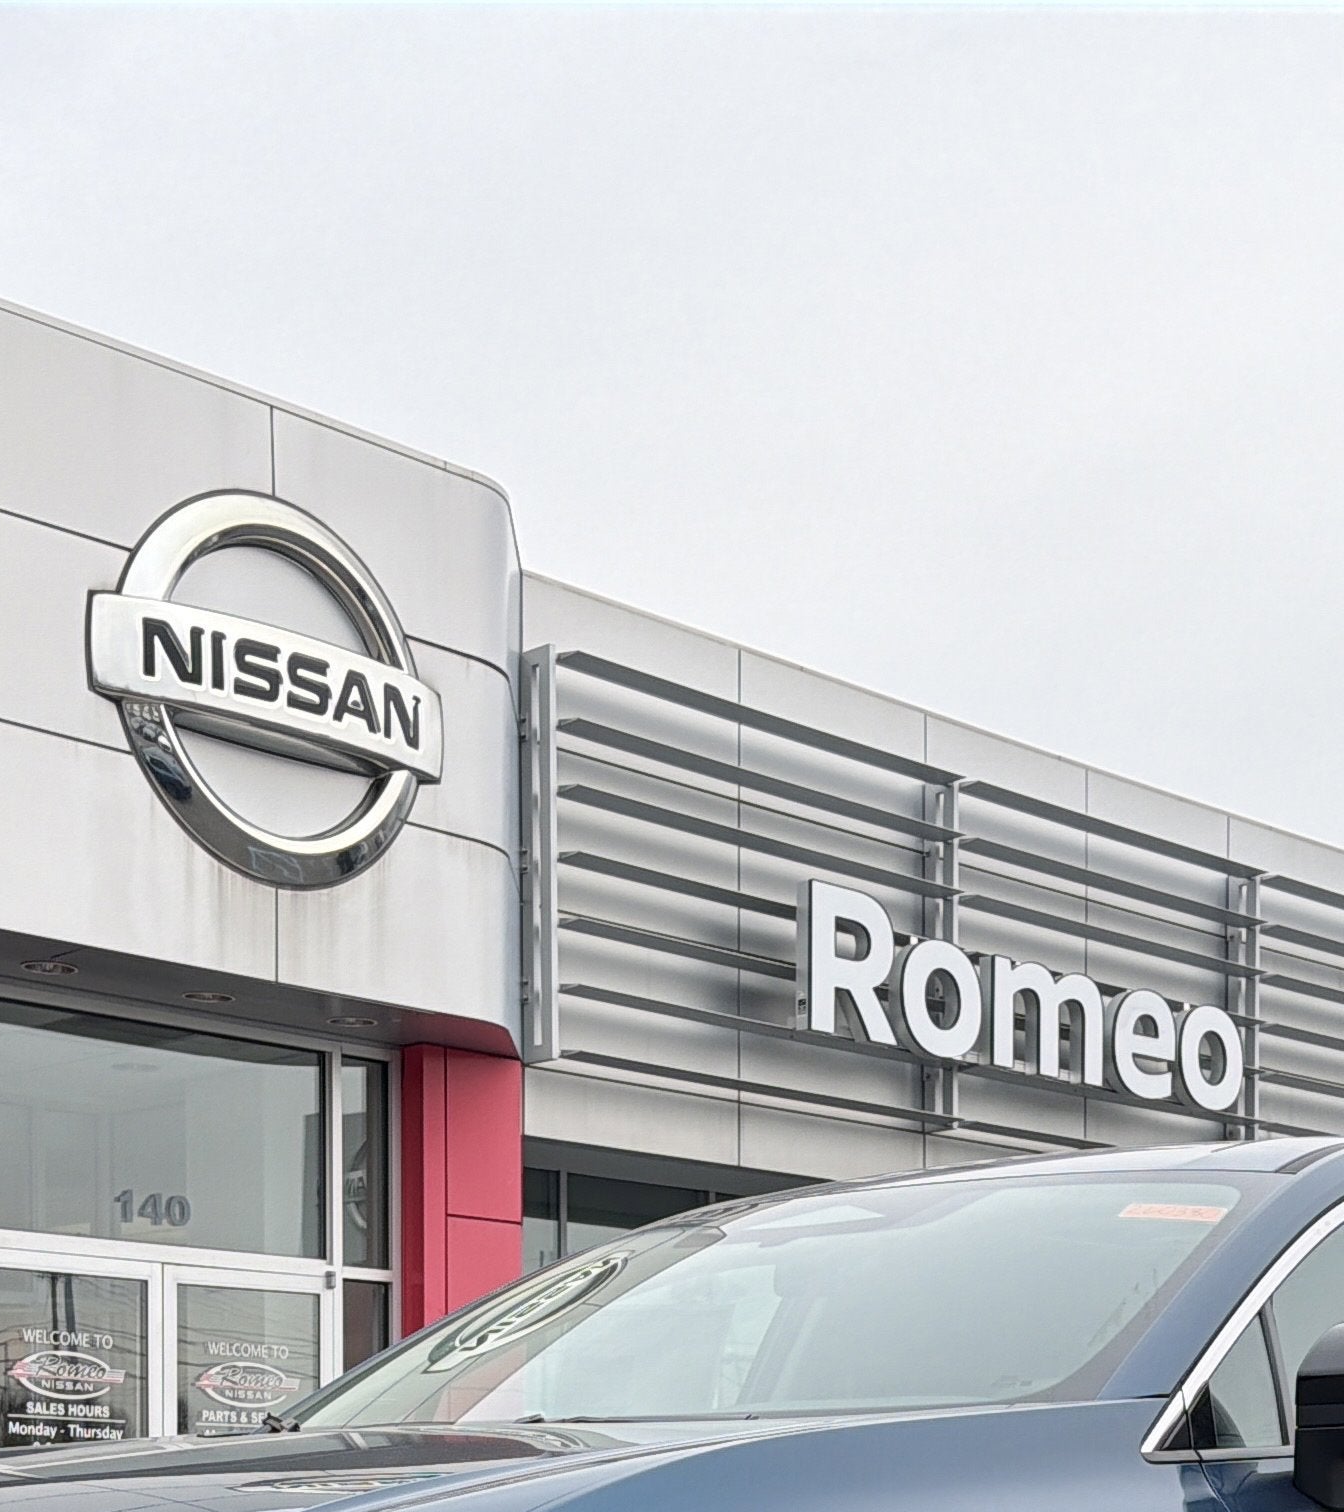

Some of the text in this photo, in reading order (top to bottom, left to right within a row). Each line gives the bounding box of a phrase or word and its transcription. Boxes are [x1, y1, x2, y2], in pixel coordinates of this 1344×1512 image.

[142, 617, 421, 750] NISSAN
[802, 879, 1244, 1111] Romeo
[114, 1189, 191, 1227] 140
[22, 1328, 113, 1349] WELCOME TO
[208, 1341, 288, 1359] WELCOME TO
[30, 1355, 107, 1379] Romeo
[218, 1365, 284, 1389] Romeo
[42, 1380, 94, 1391] NISSAN
[225, 1390, 271, 1400] NISSAN
[26, 1401, 110, 1418] SALES HOURS
[202, 1410, 237, 1423] PARTS
[240, 1411, 248, 1423] &
[8, 1421, 57, 1439] Monday
[67, 1424, 123, 1440] Thursday
